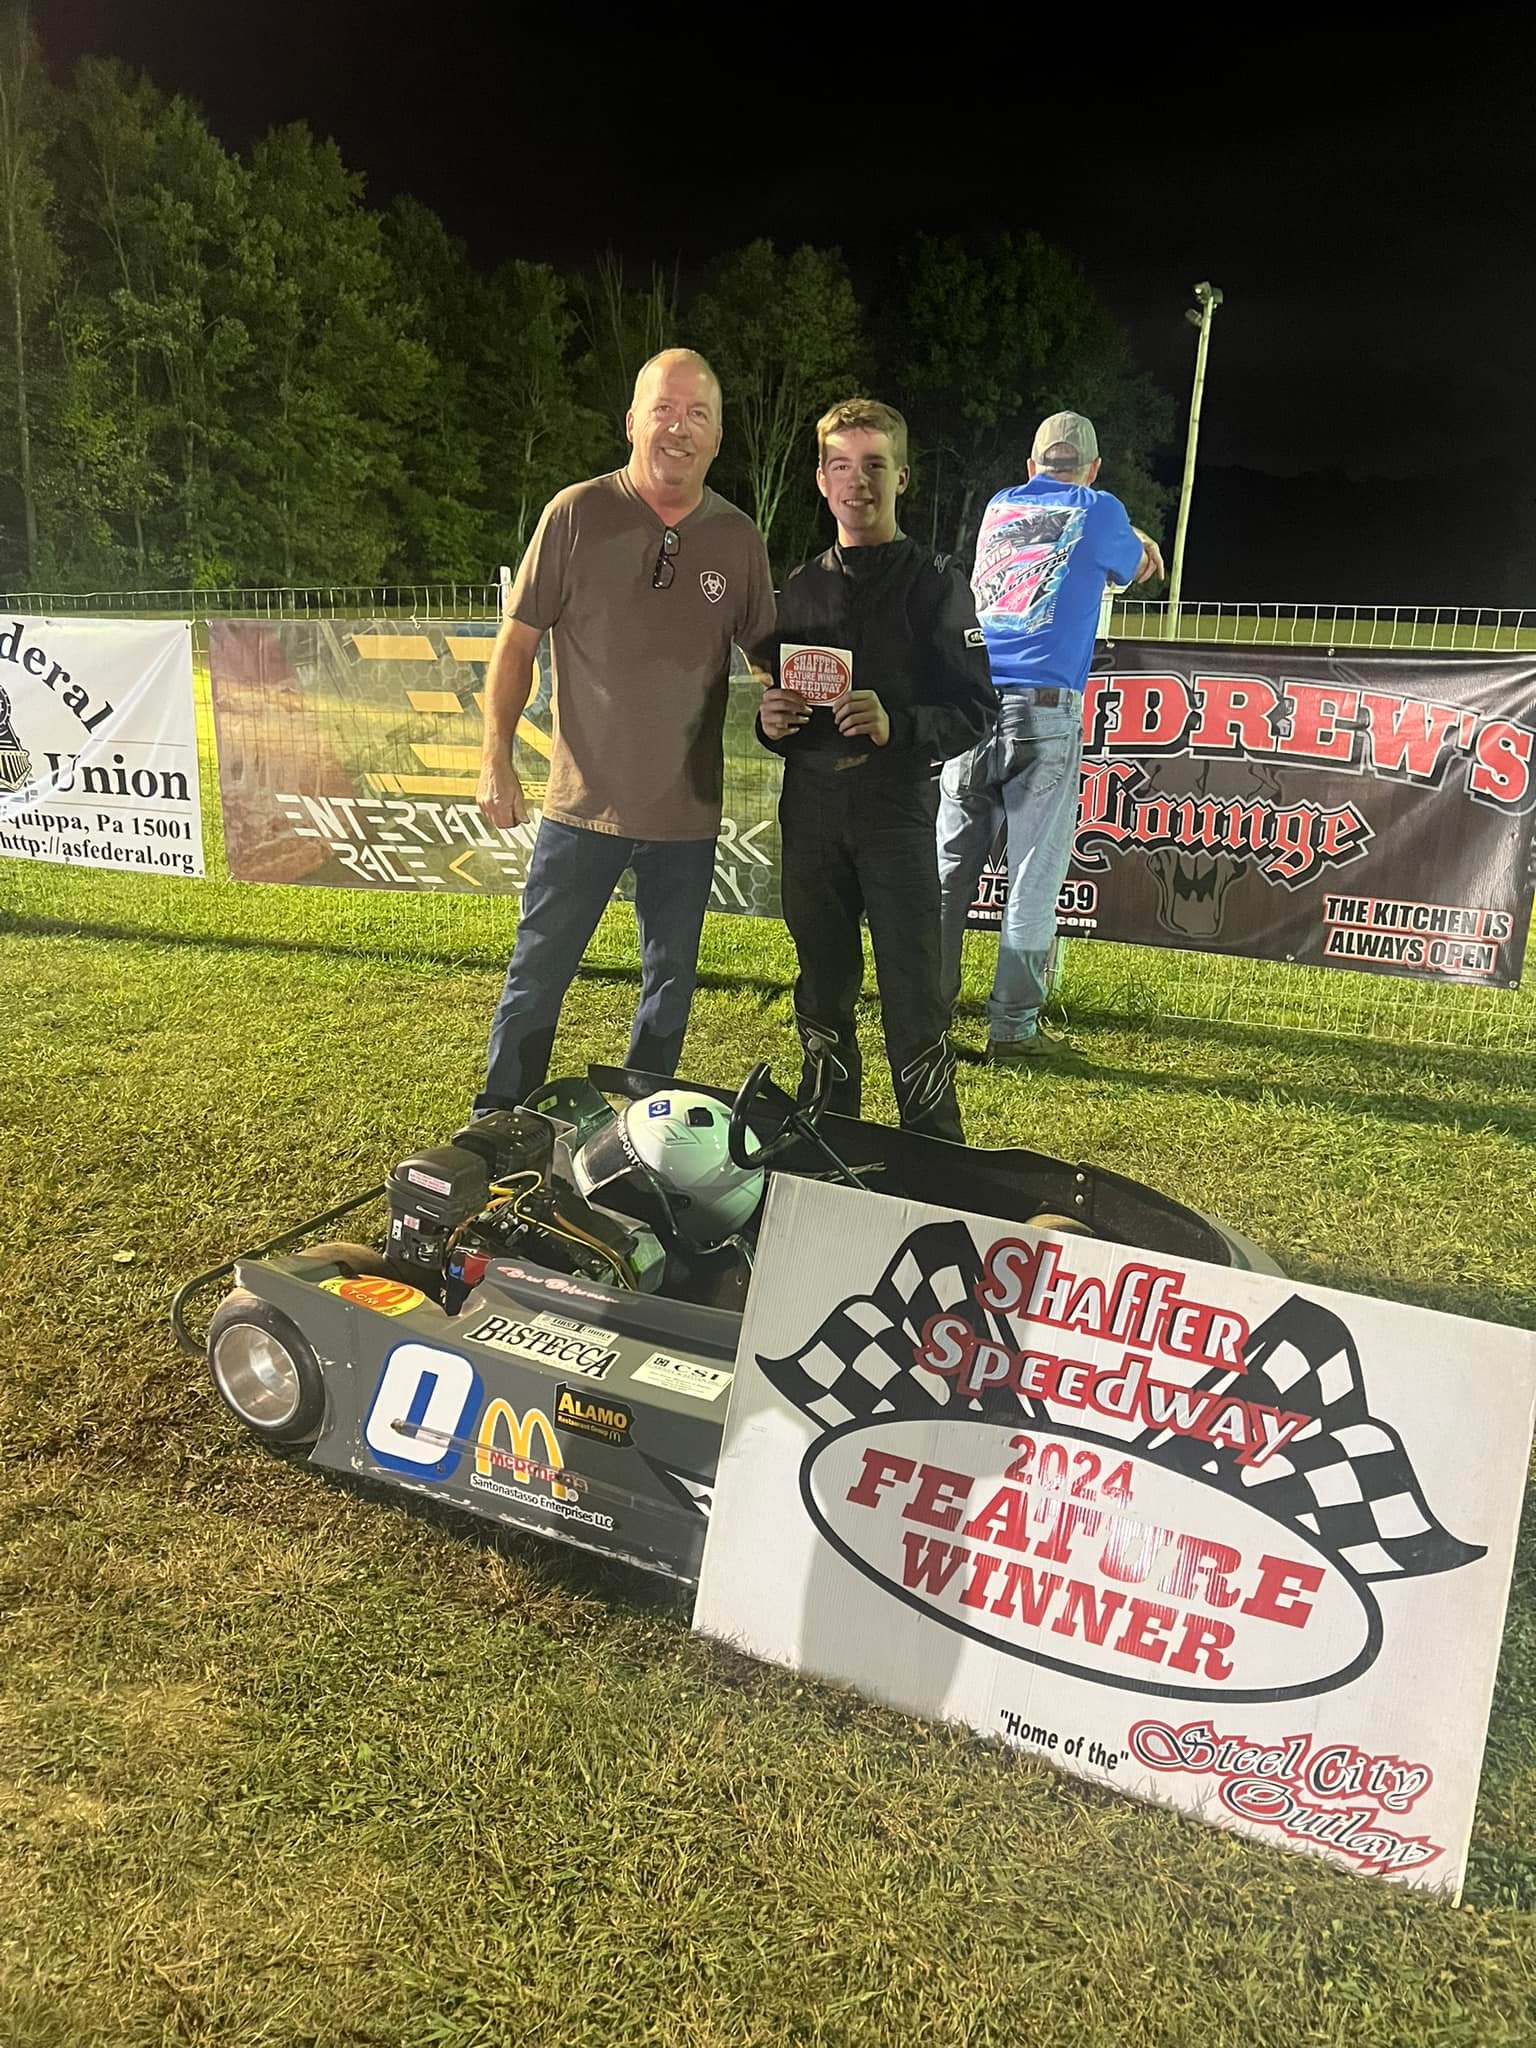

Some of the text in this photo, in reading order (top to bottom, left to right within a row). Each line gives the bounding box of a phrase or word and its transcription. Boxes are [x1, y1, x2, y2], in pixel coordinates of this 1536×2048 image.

[785, 670, 846, 683] FEATURE WINNER
[793, 654, 838, 673] SHAFFER
[788, 680, 842, 694] SPEEDWAY
[801, 690, 828, 700] 2024
[1083, 675, 1535, 803] DREW'S
[43, 752, 191, 801] Union
[96, 814, 124, 834] Pa
[132, 816, 193, 840] 15001
[1072, 760, 1363, 879] Lounge
[0, 831, 195, 874] http://asfederal.org
[330, 842, 447, 884] RACE
[1327, 897, 1510, 939] THE KITCHEN IS
[1329, 931, 1494, 970] ALWAYS OPEN
[467, 1316, 617, 1379] BISTECCA
[674, 1364, 720, 1381] CSI
[1003, 1434, 1134, 1504] 2024
[472, 1475, 614, 1529] Santonastasso Enterprises LLC
[846, 1448, 1326, 1629] FEATURE
[900, 1532, 1235, 1681] WINNER
[1000, 1710, 1431, 1810] "Home of the" Steel City
